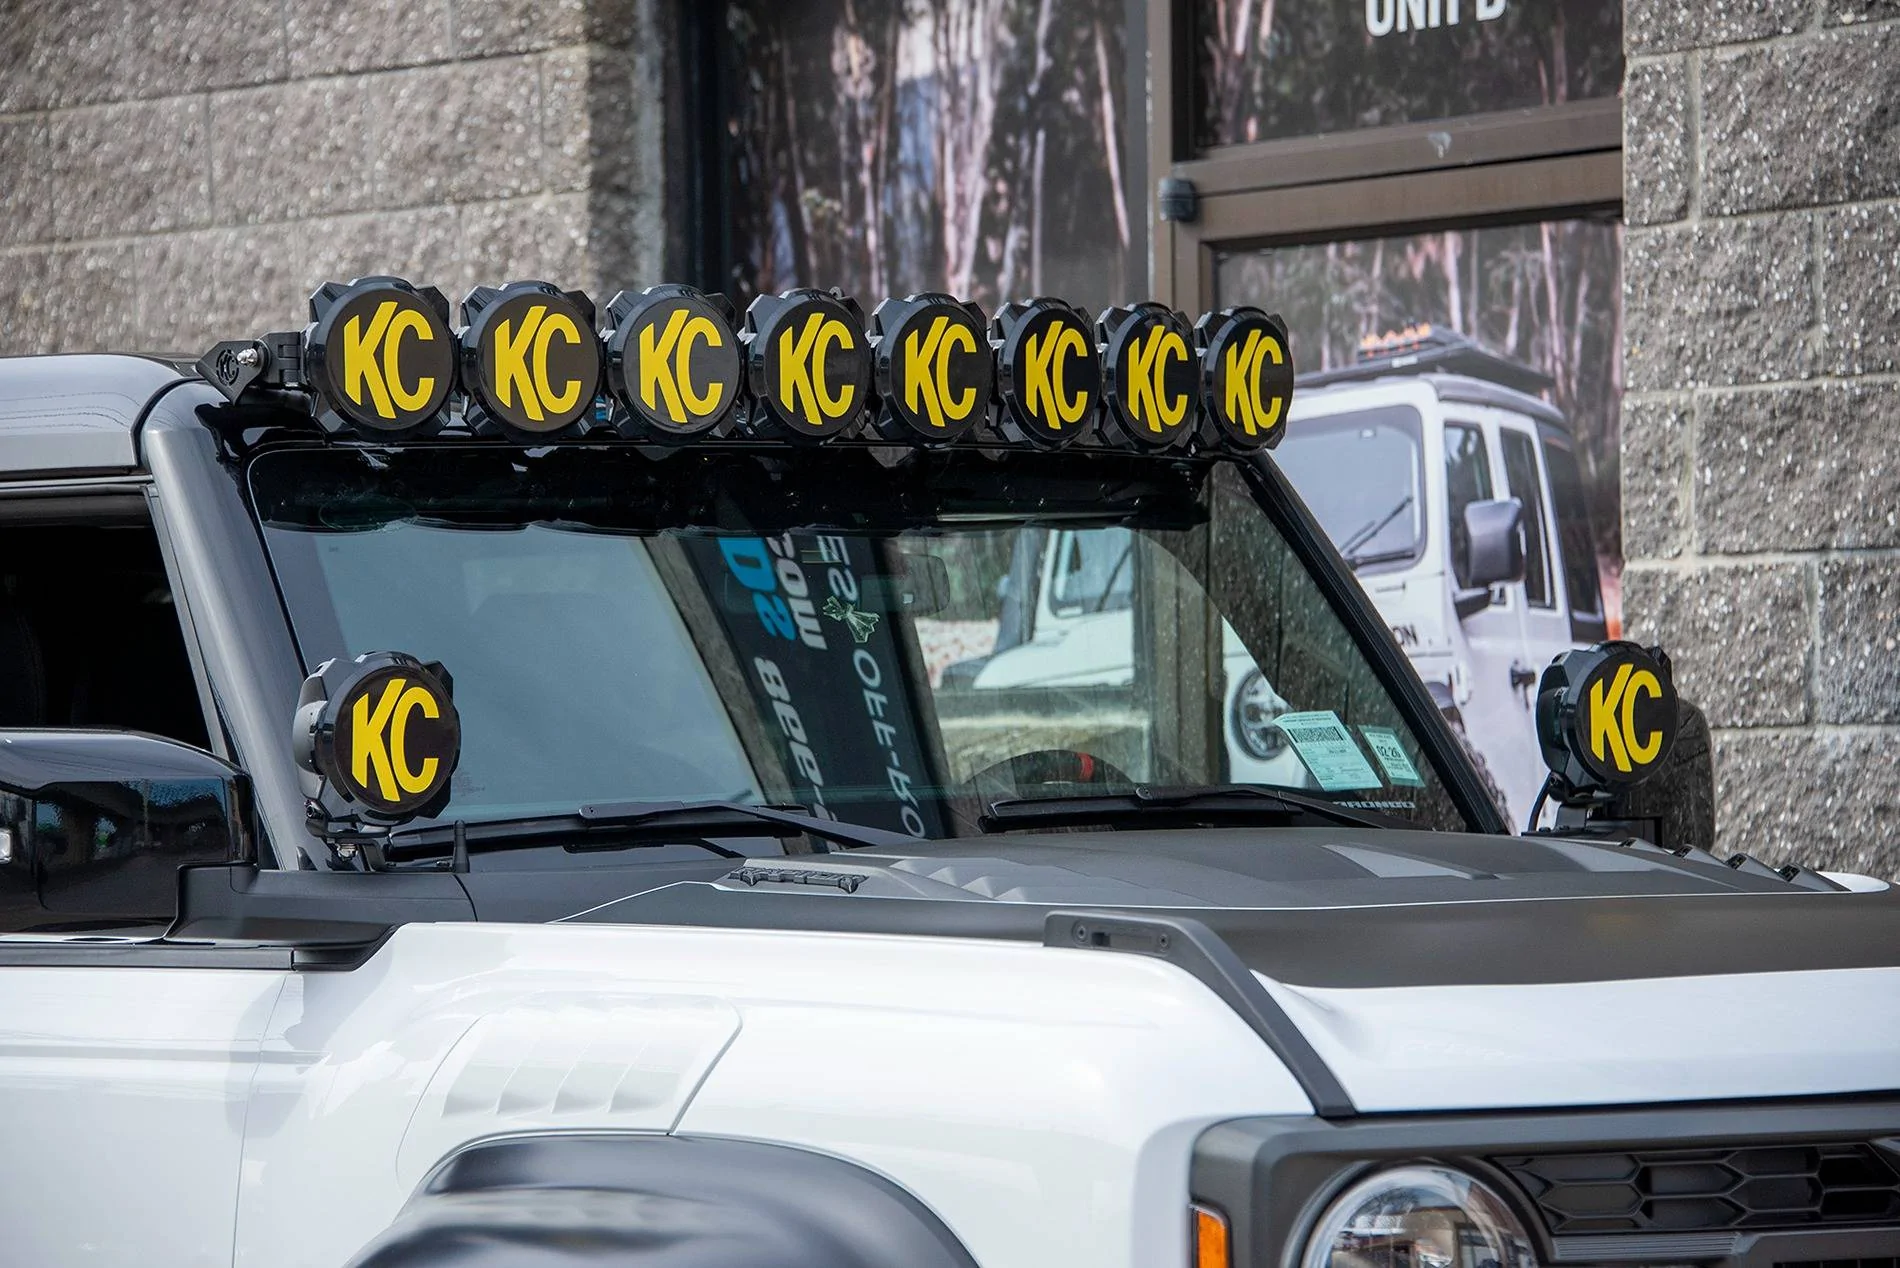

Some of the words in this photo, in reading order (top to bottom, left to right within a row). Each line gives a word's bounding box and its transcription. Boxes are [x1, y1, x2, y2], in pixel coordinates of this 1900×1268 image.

[344, 301, 434, 419] KC
[495, 305, 581, 422] KC
[639, 309, 724, 424] KC
[779, 312, 855, 426] KC
[904, 316, 977, 428] KC
[1025, 320, 1088, 430] KC
[1128, 325, 1188, 433] KC
[1225, 329, 1283, 436] KC
[351, 678, 440, 802] KC
[1589, 663, 1663, 773] KC
